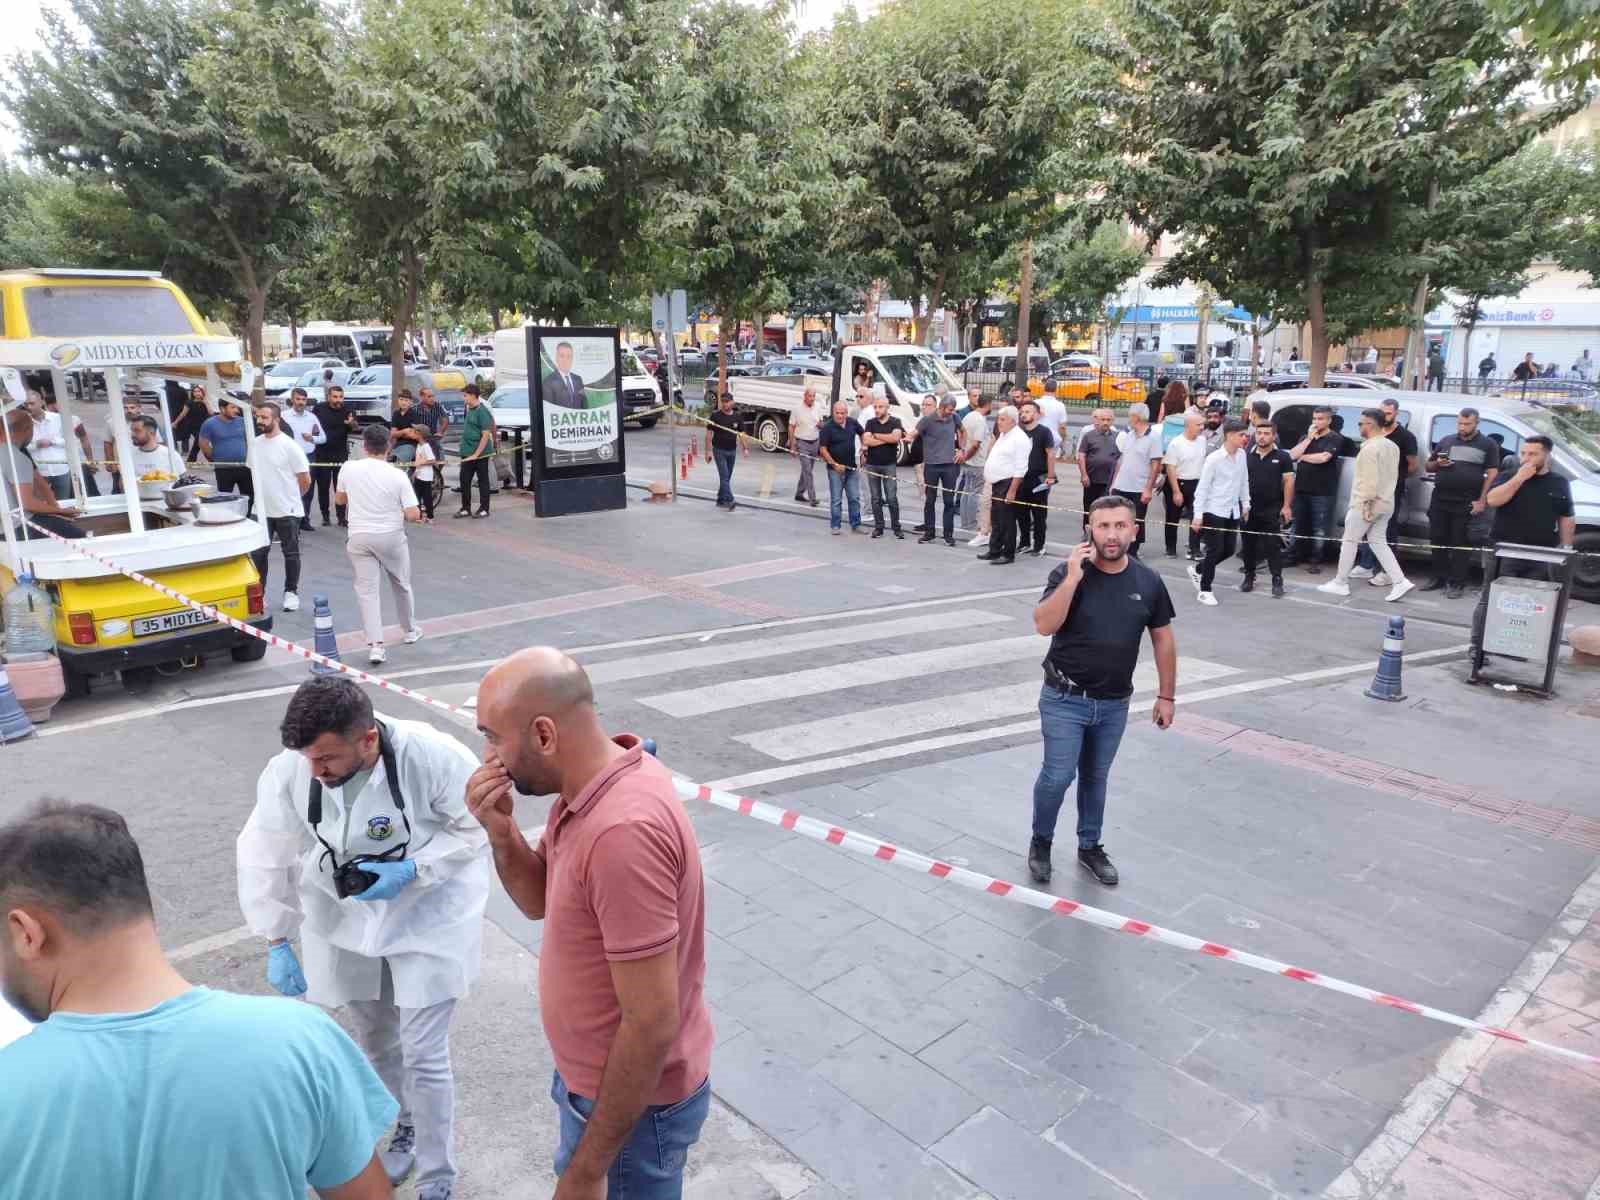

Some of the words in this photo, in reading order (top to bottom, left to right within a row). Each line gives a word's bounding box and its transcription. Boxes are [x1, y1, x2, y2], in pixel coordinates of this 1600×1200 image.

[154, 340, 204, 359] ÖZCAN
[550, 410, 610, 426] BAYRAM
[142, 619, 160, 633] 35
